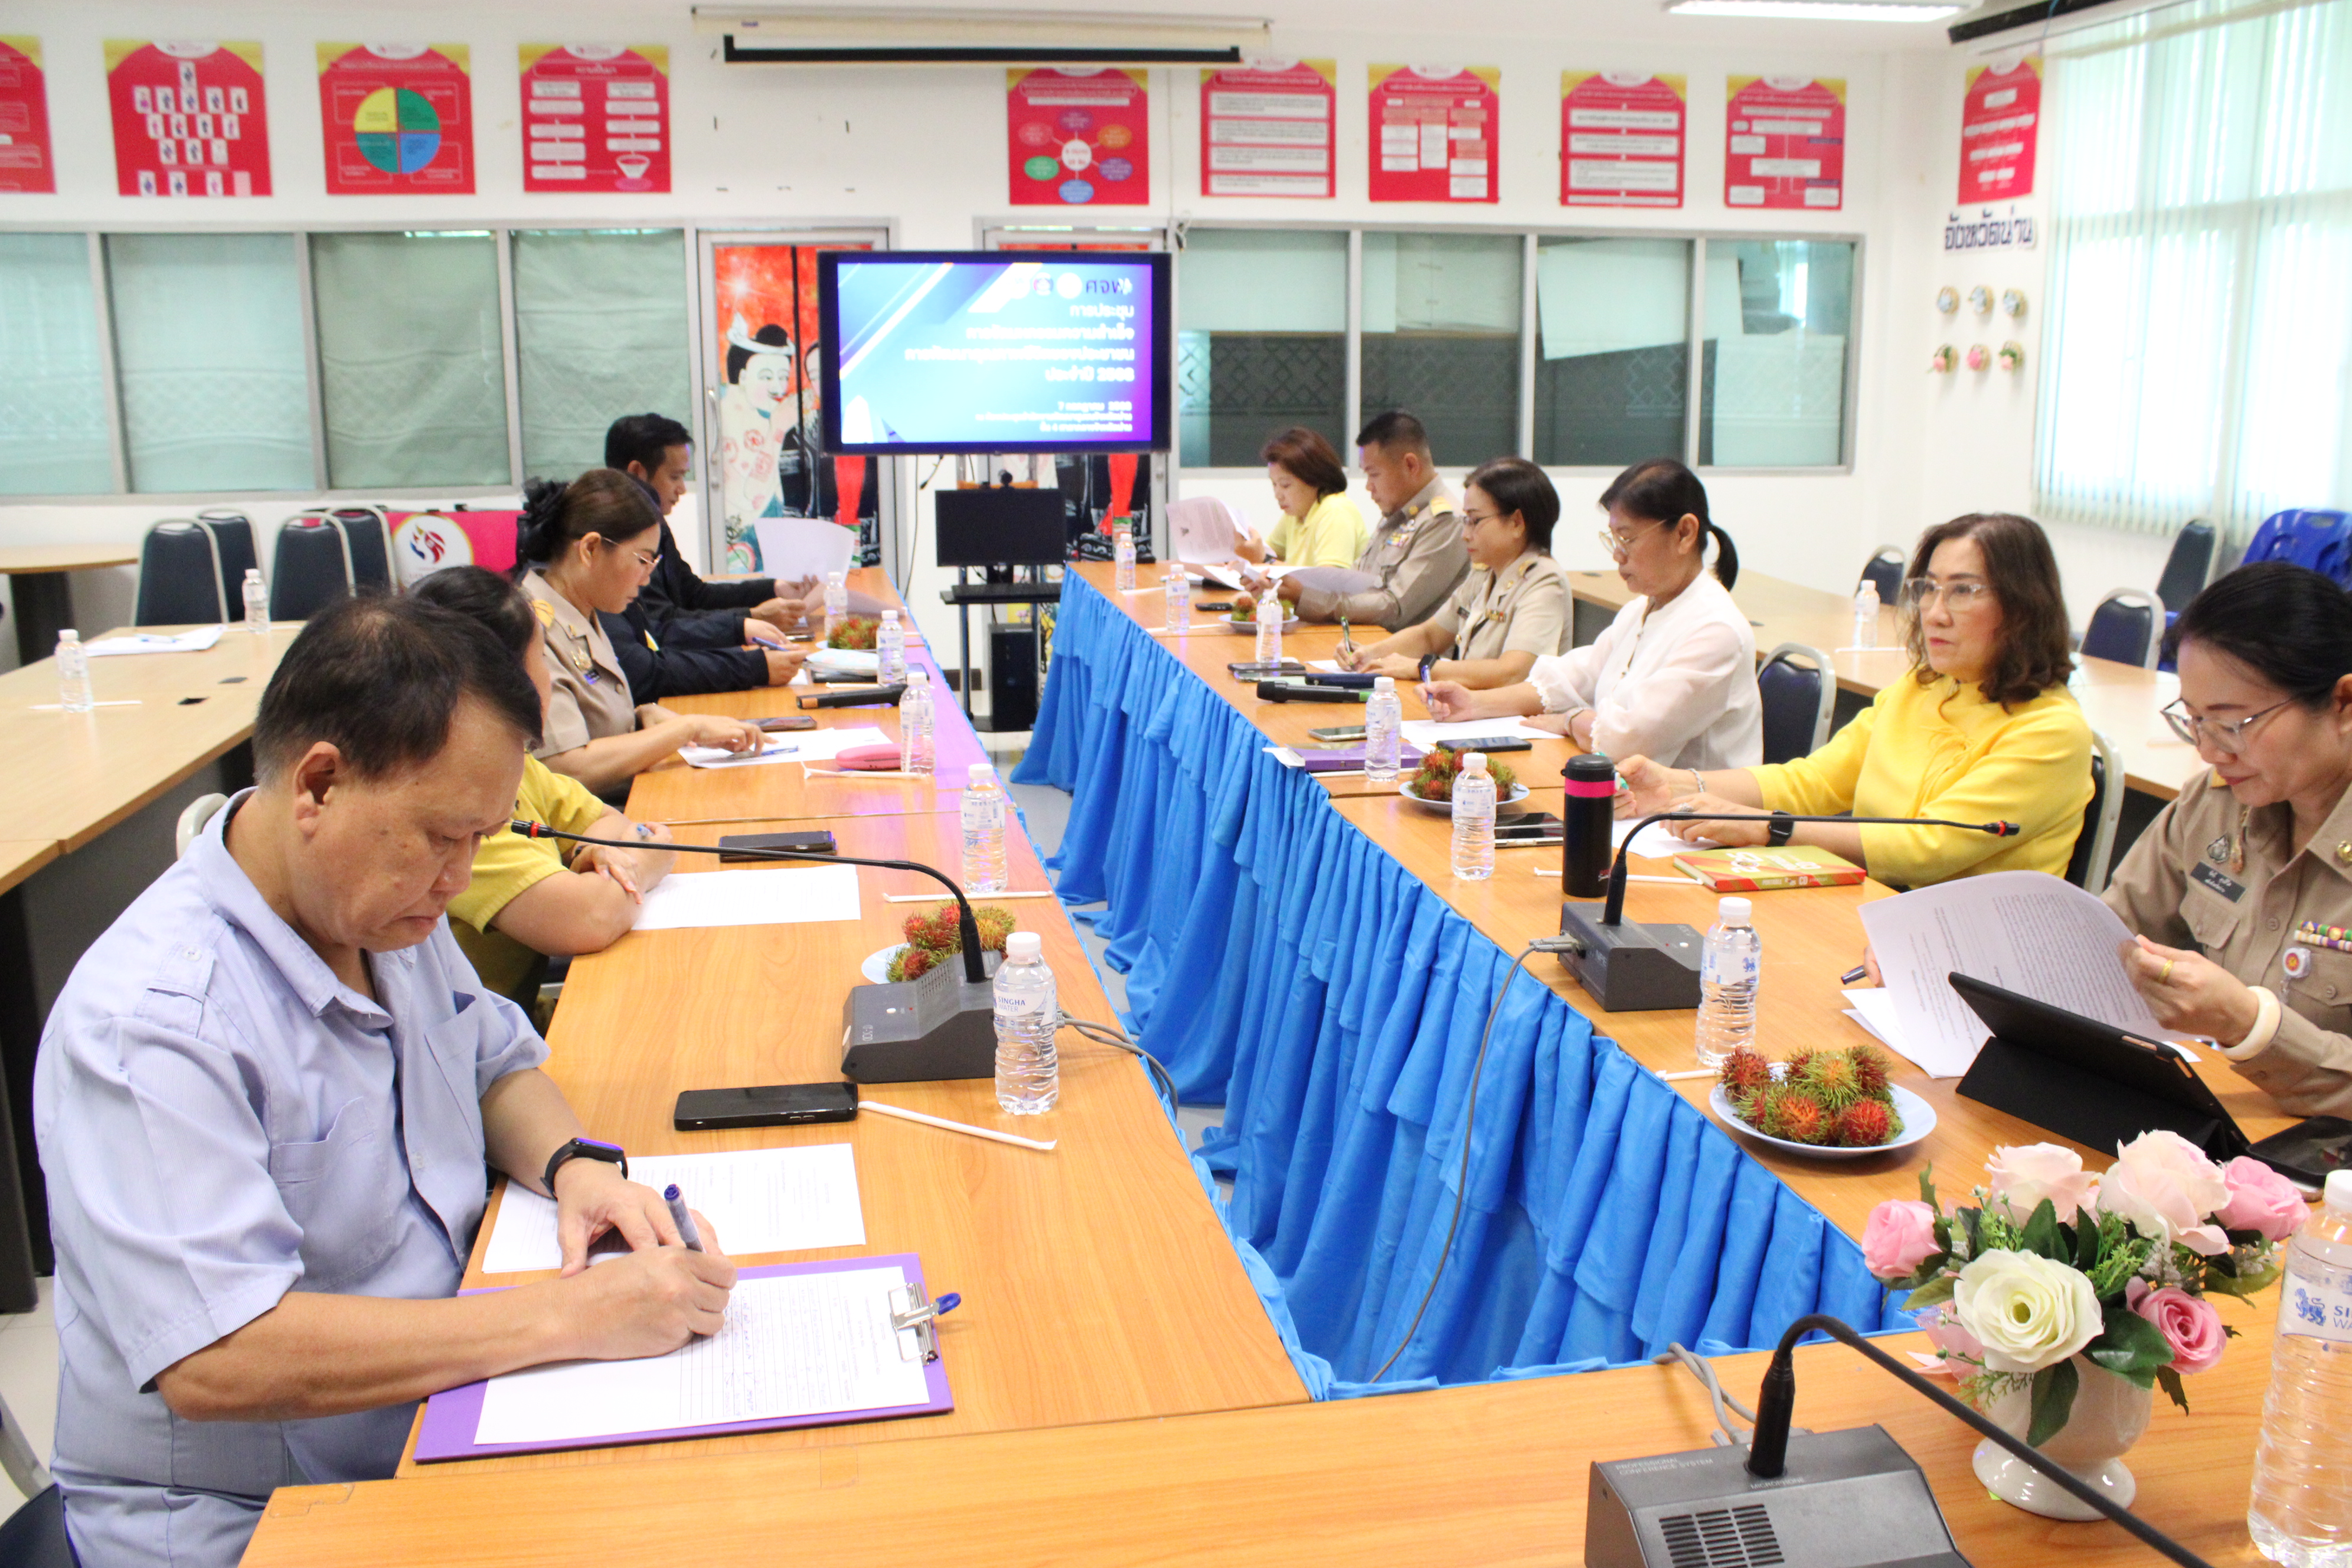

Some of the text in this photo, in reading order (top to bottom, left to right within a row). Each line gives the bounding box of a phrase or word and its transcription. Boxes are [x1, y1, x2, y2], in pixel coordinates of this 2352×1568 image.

[1945, 204, 2033, 250] จังหวัดน่าน
[1070, 303, 1134, 320] การประชุม
[1045, 365, 1095, 381] ประจำปี
[998, 996, 1026, 1006] SINGHA
[998, 1004, 1018, 1012] WATER
[2334, 1305, 2352, 1318] SI
[1615, 1457, 1678, 1470] PROFESSIONAL
[1619, 1459, 1714, 1475] CONFERENCE SYSTEM
[1750, 1477, 1805, 1489] MICROPHONE
